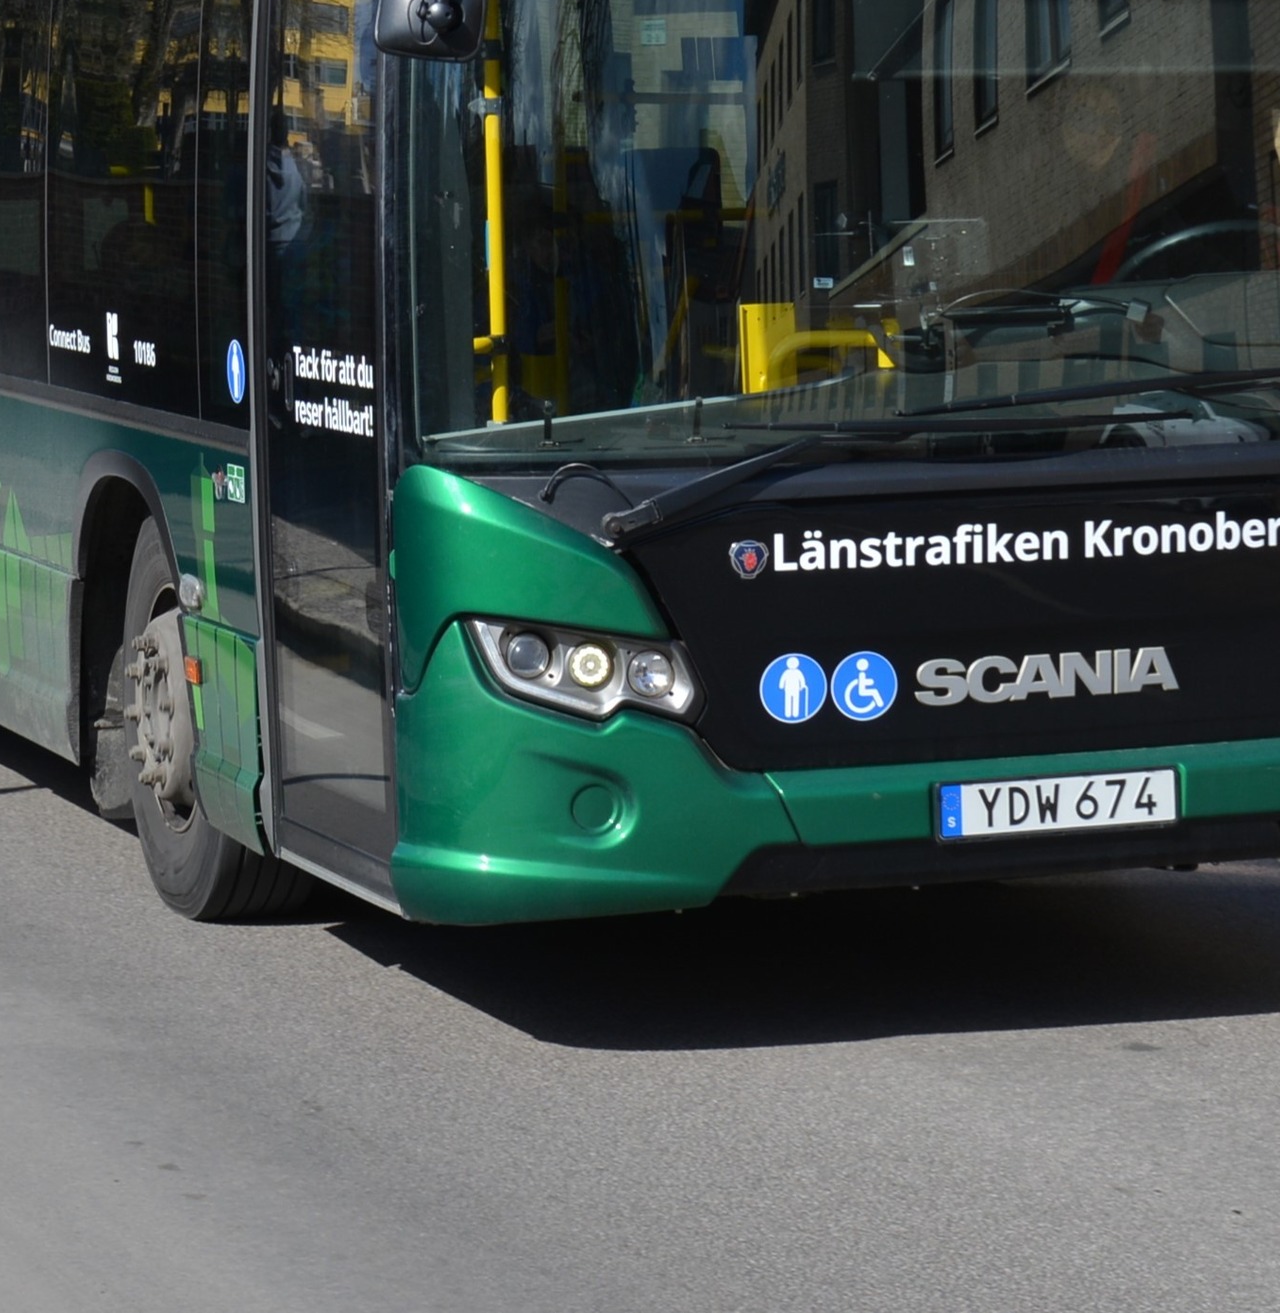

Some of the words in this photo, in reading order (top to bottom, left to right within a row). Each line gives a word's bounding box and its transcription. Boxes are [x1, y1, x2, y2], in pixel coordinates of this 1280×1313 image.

[49, 323, 77, 352] Connect
[77, 328, 91, 354] Bus
[293, 345, 320, 380] Tack
[321, 349, 338, 383] för
[339, 354, 356, 386] att
[357, 354, 374, 389] du
[295, 399, 323, 428] reser
[324, 396, 374, 438] hållbart!
[773, 522, 1068, 573] Länstrafiken
[914, 646, 1180, 707] SCANIA
[978, 784, 1061, 828] YDW
[1075, 776, 1158, 821] 674
